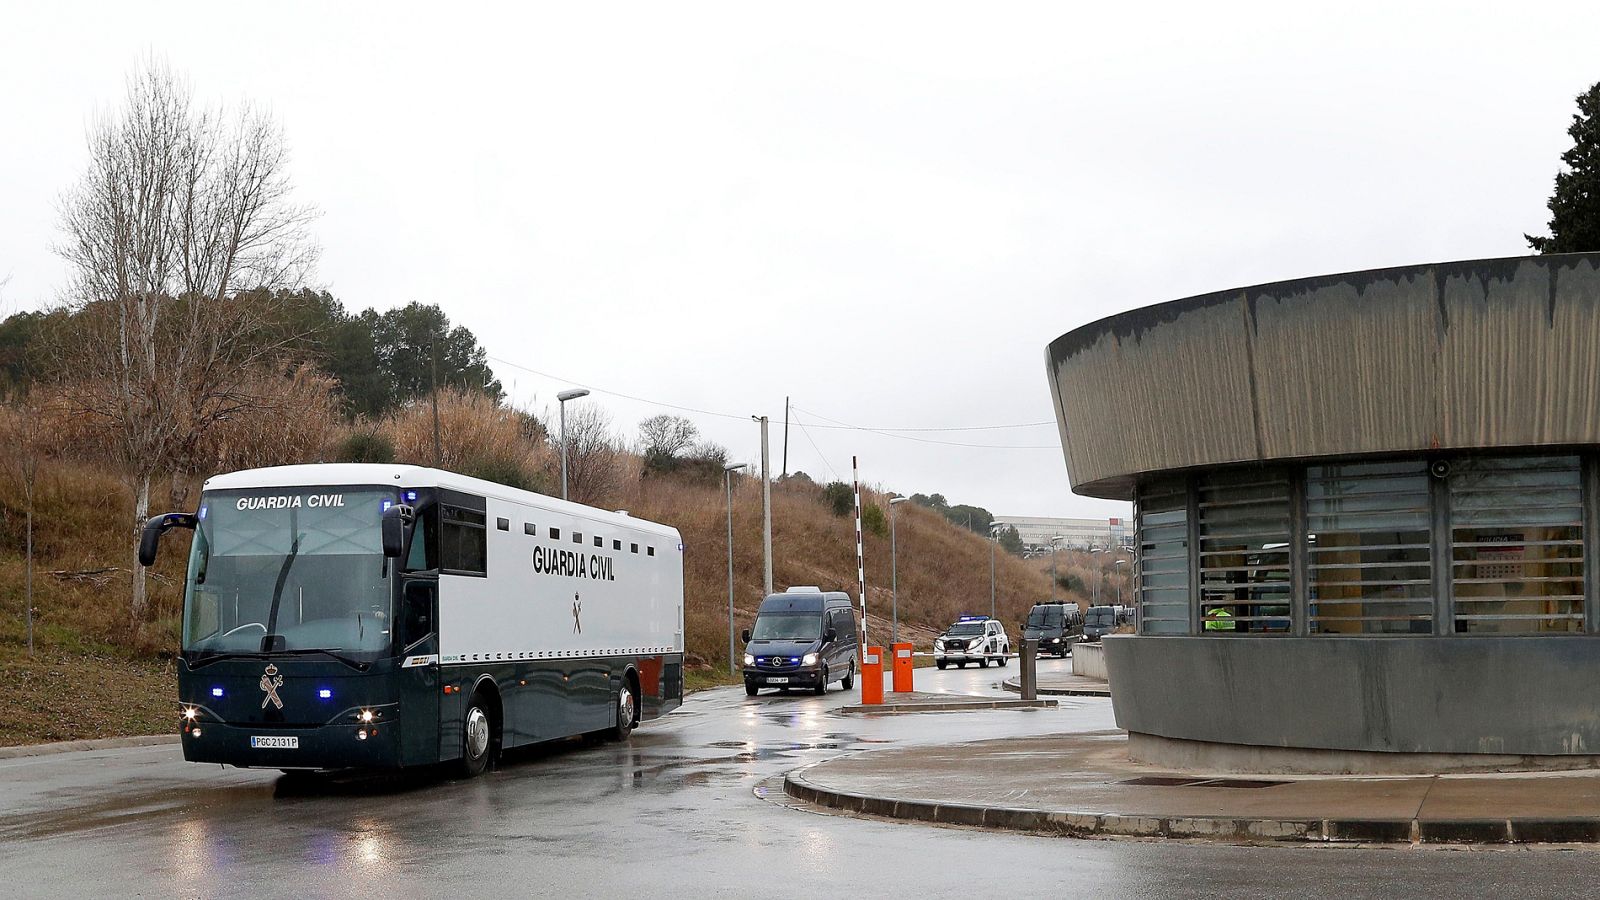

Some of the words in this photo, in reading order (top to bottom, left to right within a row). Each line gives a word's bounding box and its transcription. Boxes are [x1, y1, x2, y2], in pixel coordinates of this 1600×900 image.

[236, 495, 302, 511] GUARDIA
[307, 494, 345, 508] CIVIL
[533, 545, 587, 578] GUARDIA
[590, 554, 615, 581] CIVIL
